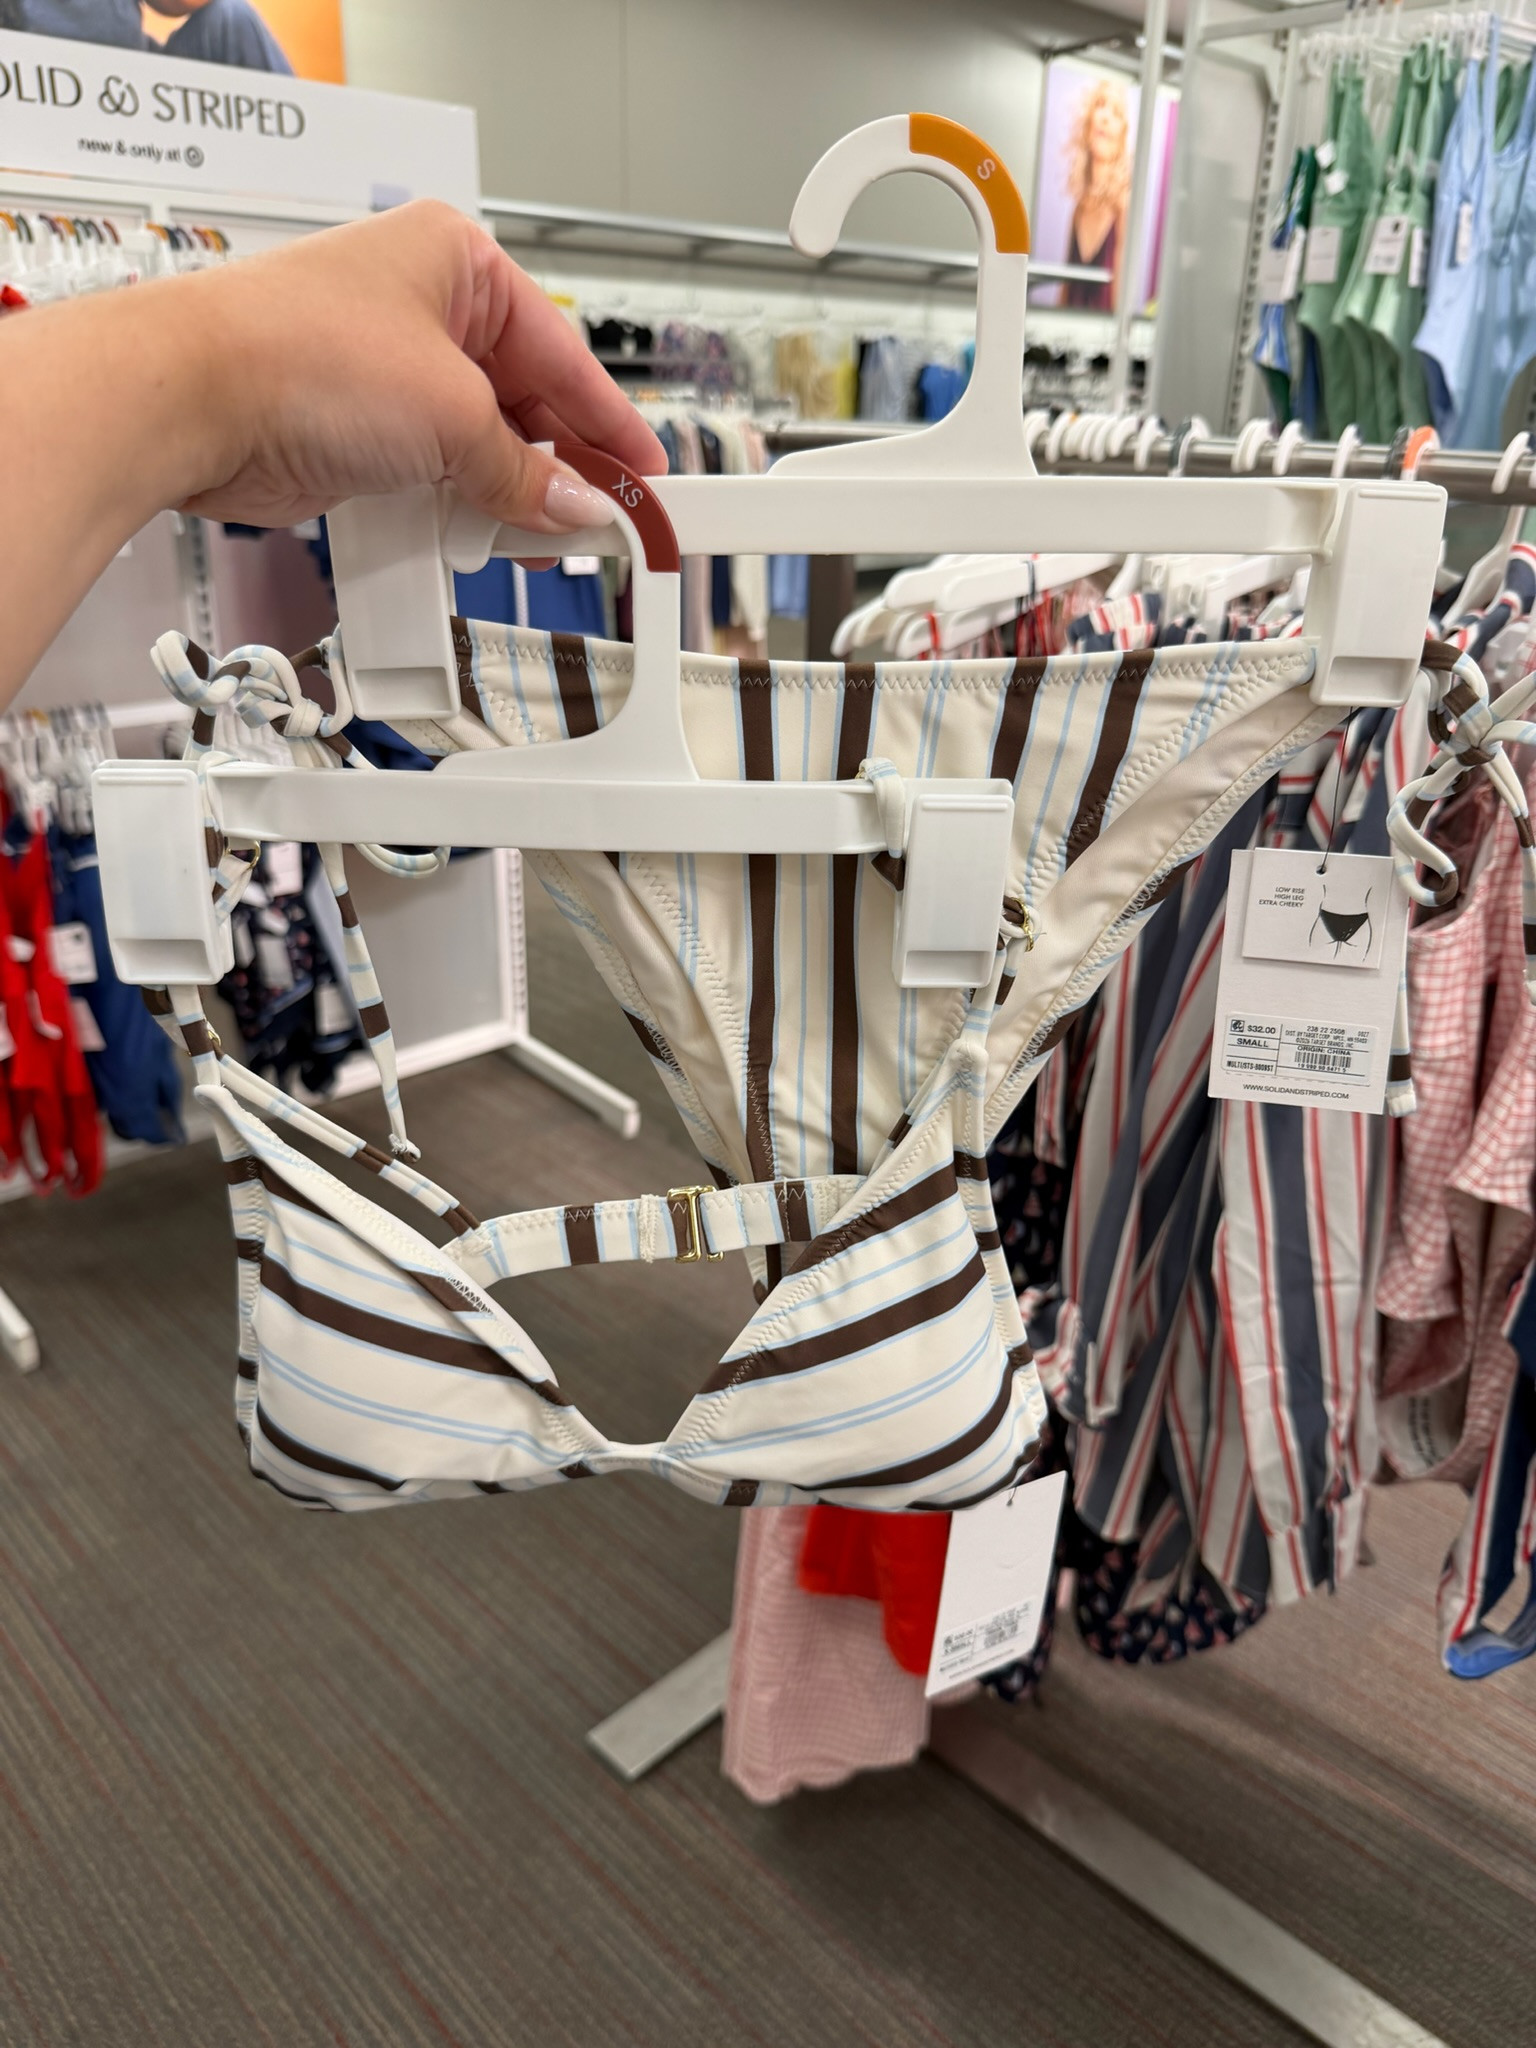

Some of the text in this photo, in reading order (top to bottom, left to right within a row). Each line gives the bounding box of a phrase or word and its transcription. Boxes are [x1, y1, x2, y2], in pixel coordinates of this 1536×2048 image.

[98, 75, 140, 117] &
[152, 82, 306, 139] STRIPED
[78, 138, 113, 154] new
[115, 138, 127, 156] &
[129, 143, 164, 164] only
[976, 158, 996, 181] S
[611, 473, 644, 508] XS
[1247, 1024, 1276, 1034] $32.00
[1236, 1037, 1269, 1048] SMALL
[1297, 1045, 1351, 1056] ORIGIN: CHINA
[1243, 1084, 1349, 1099] WWW.SOLIDANDSTRIPED.COM
